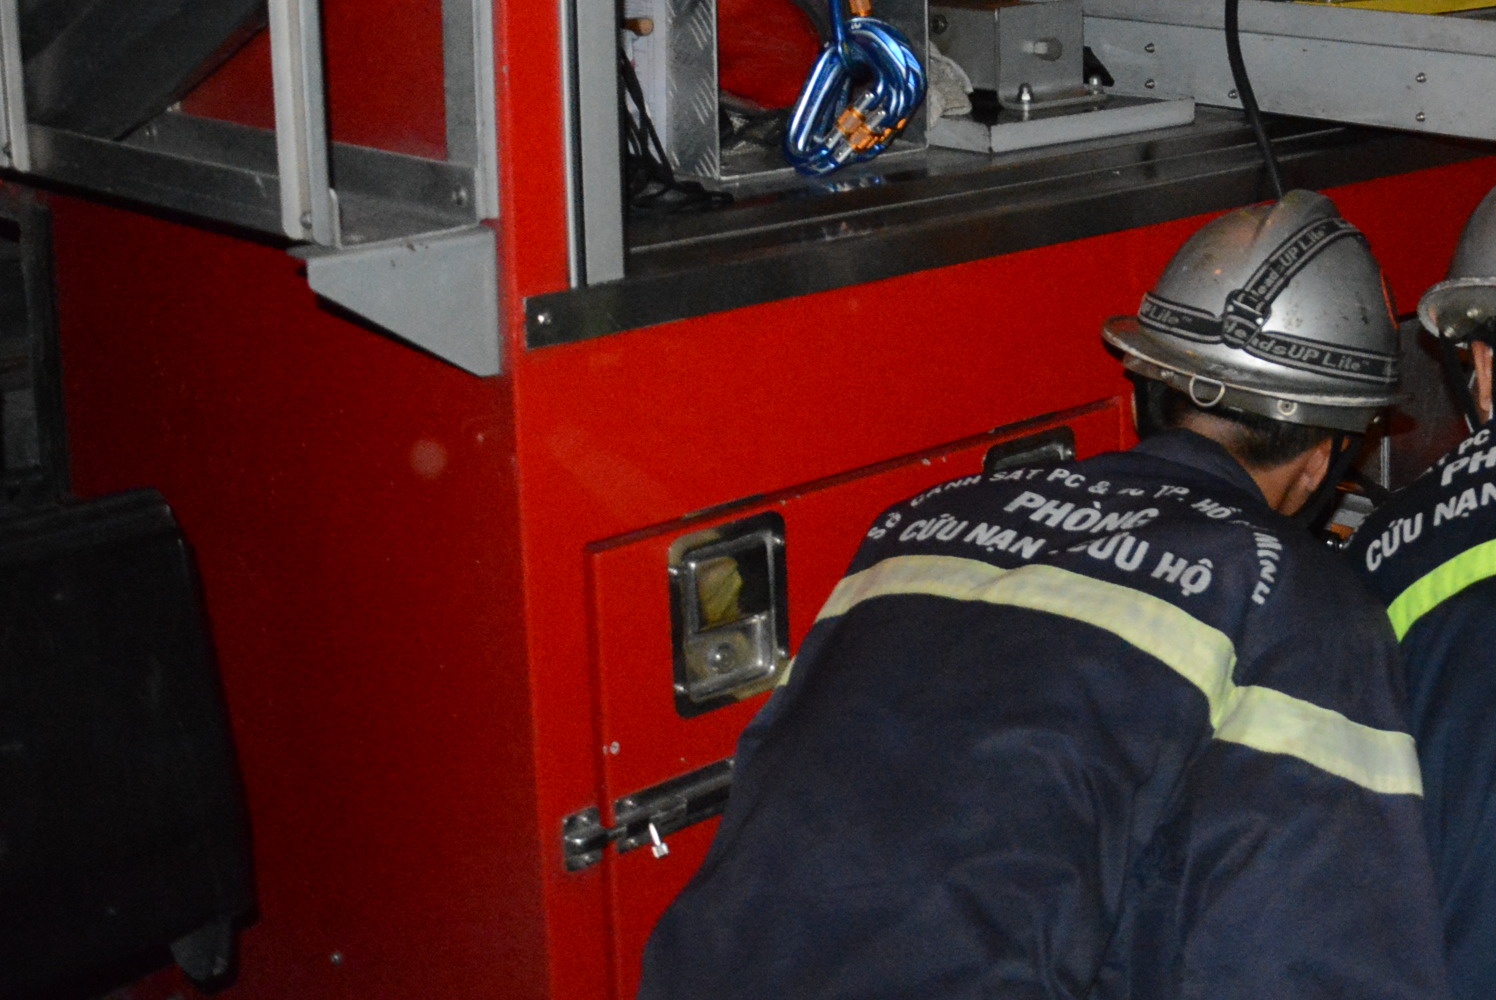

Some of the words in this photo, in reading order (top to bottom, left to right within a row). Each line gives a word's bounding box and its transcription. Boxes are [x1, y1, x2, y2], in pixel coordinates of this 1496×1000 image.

[1458, 428, 1490, 455] PC
[1046, 468, 1086, 488] PC
[1003, 490, 1160, 534] PHÒNG
[899, 513, 969, 542] CỨU
[963, 522, 1047, 560] NẠN
[1151, 552, 1214, 597] HỘ
[1365, 512, 1423, 572] CỨU
